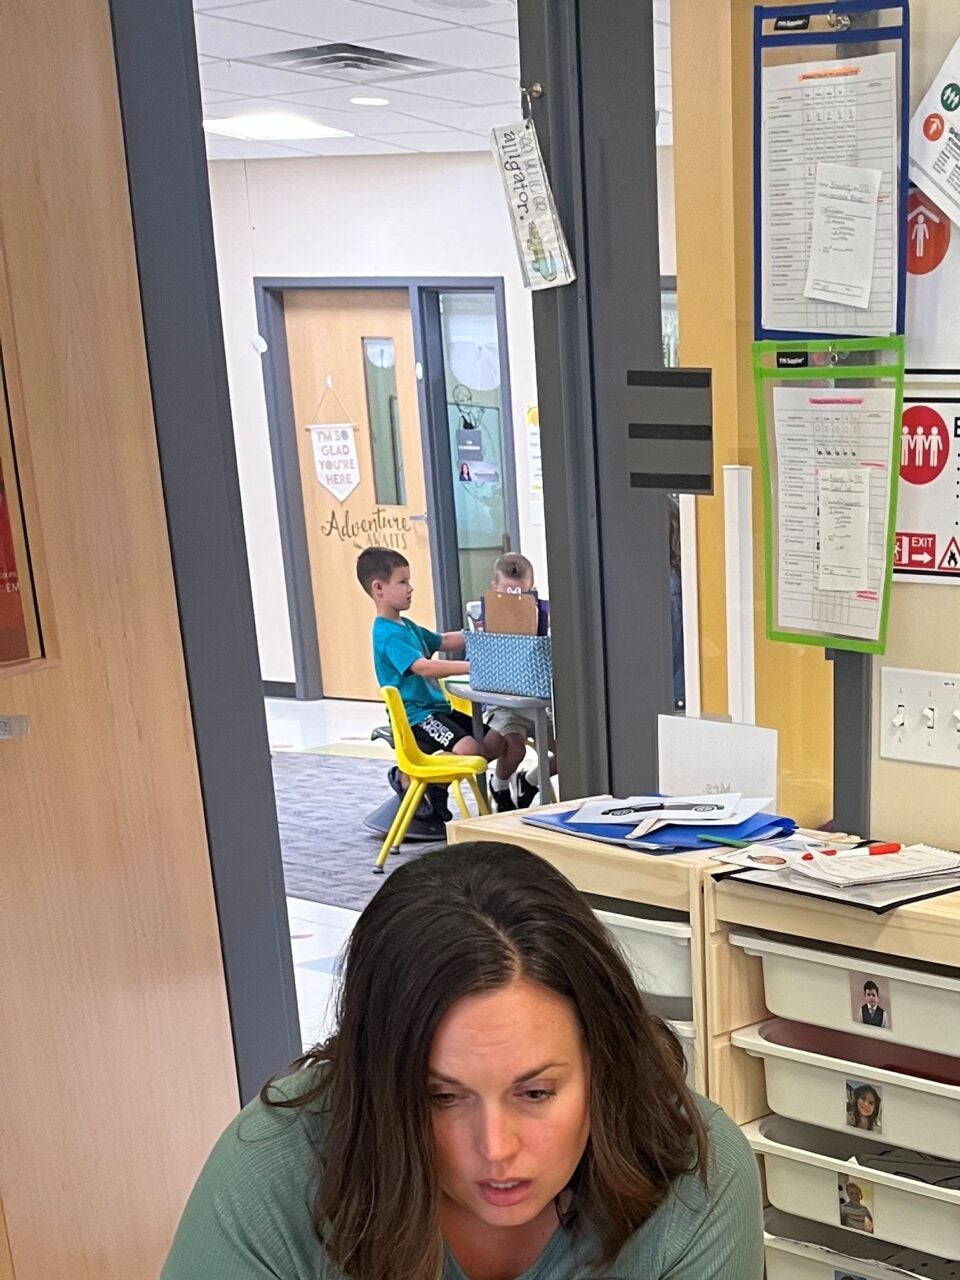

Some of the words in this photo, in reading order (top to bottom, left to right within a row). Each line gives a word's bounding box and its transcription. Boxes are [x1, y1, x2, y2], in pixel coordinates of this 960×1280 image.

[321, 444, 350, 456] GLAD
[319, 459, 356, 471] YOU'RE
[326, 474, 353, 485] HERE
[320, 507, 411, 541] Adventure
[911, 536, 933, 548] EXIT
